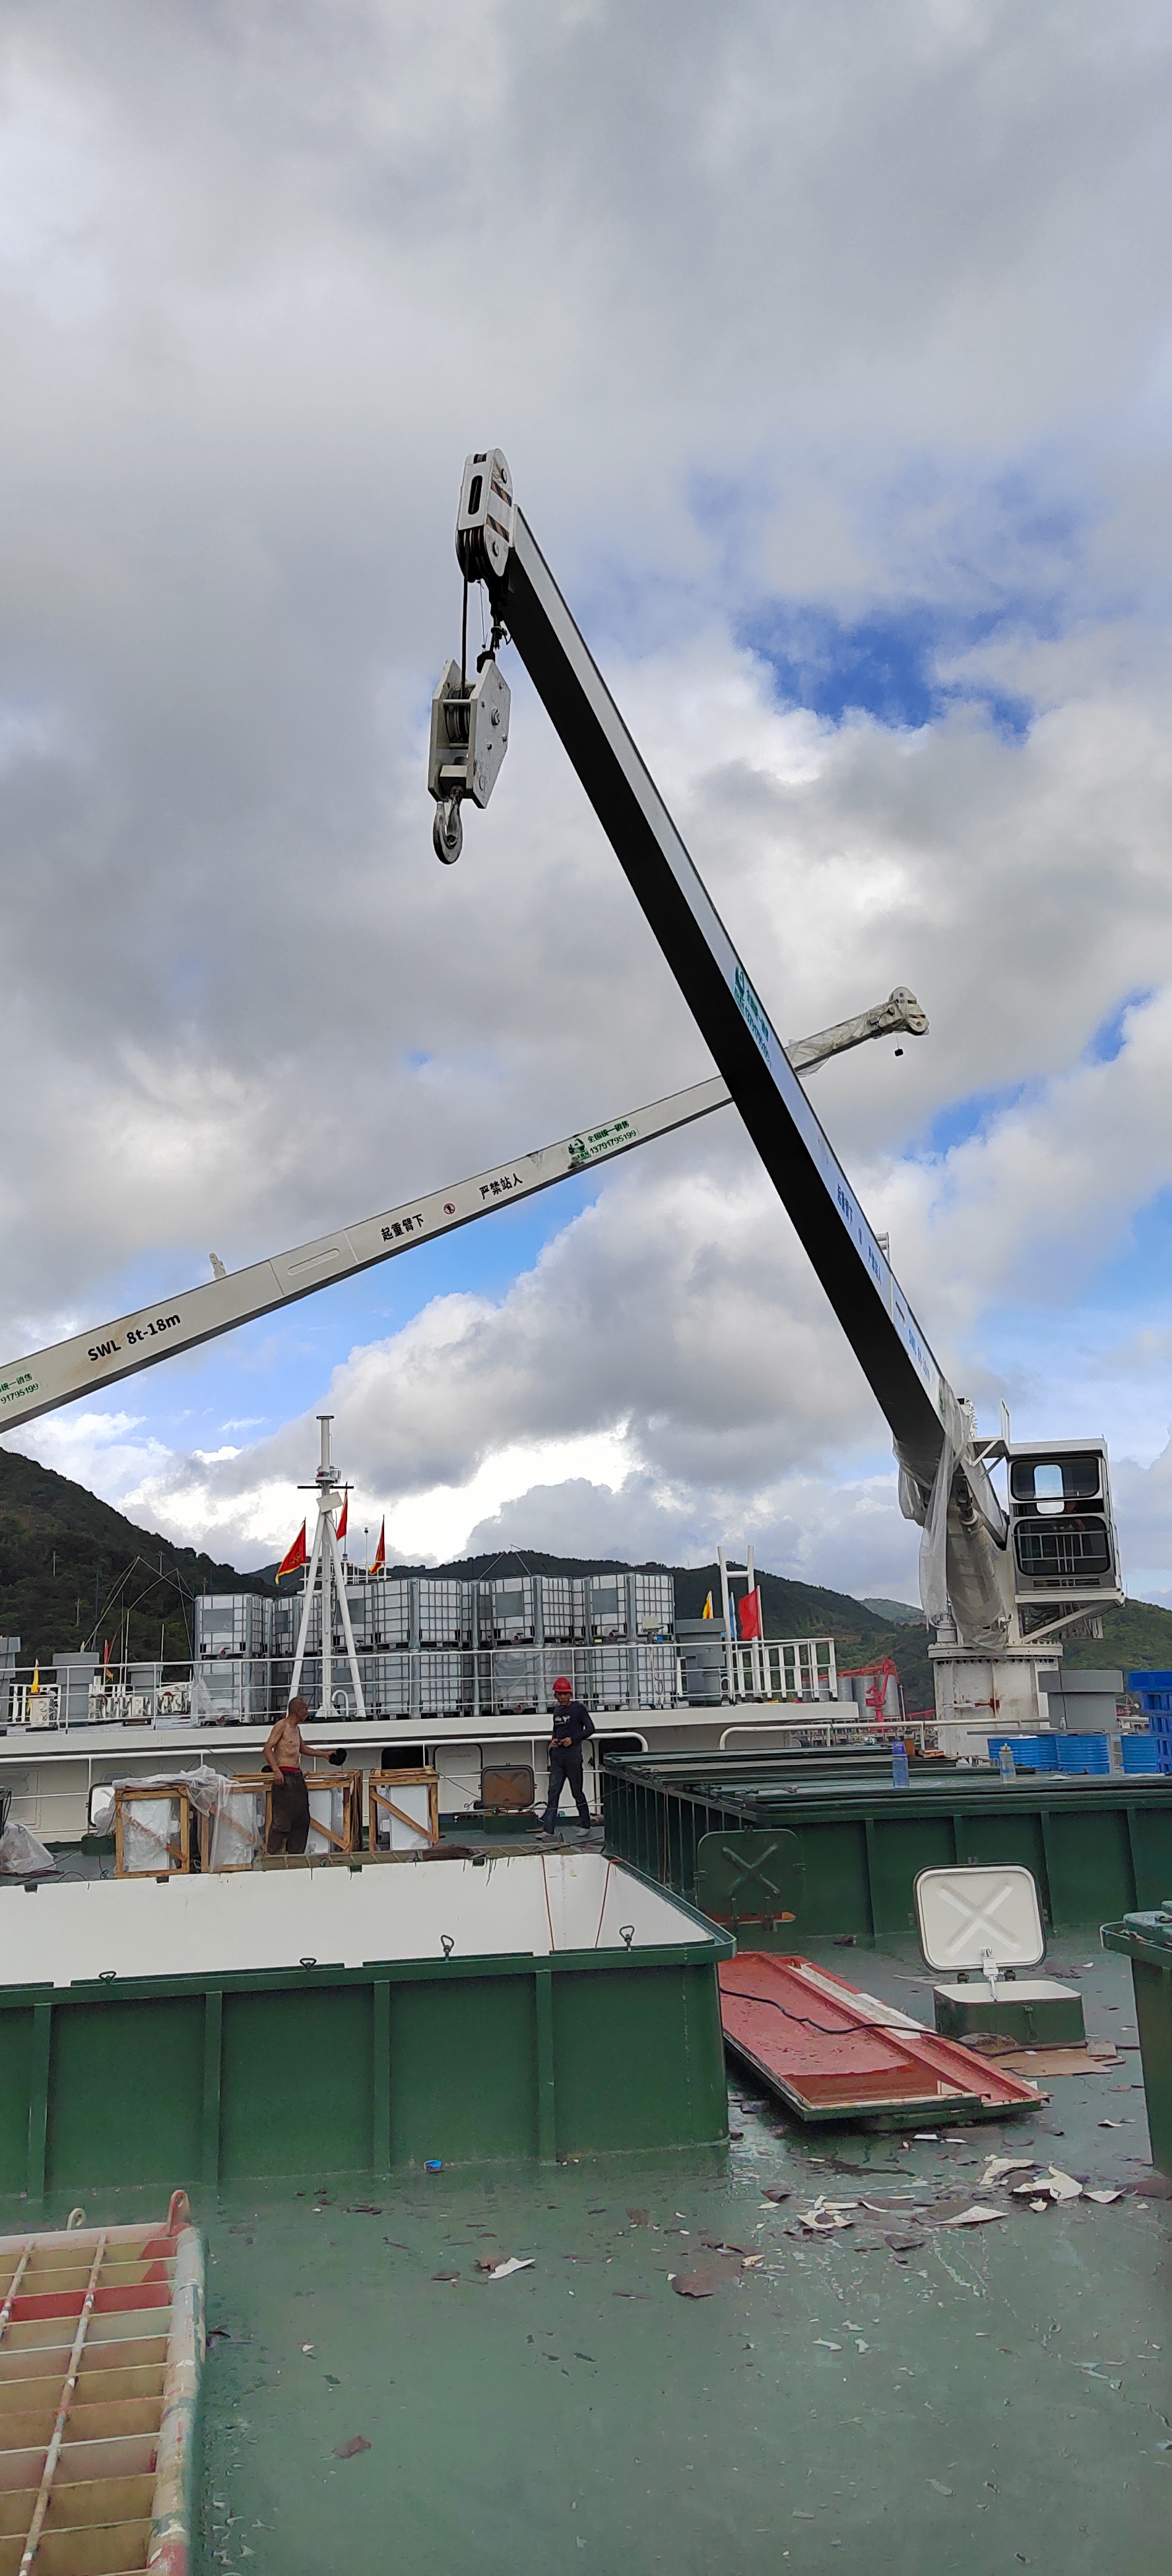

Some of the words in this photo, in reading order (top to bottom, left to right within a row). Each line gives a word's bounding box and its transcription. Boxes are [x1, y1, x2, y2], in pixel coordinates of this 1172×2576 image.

[588, 1120, 630, 1143] 全国统一销售
[590, 1130, 637, 1154] 13791795199
[479, 1173, 523, 1200] 严禁站人
[381, 1213, 424, 1242] 起重臂下
[87, 1340, 121, 1361] SWL
[126, 1314, 181, 1344] 8t-18m
[0, 1373, 32, 1392] 统一销售
